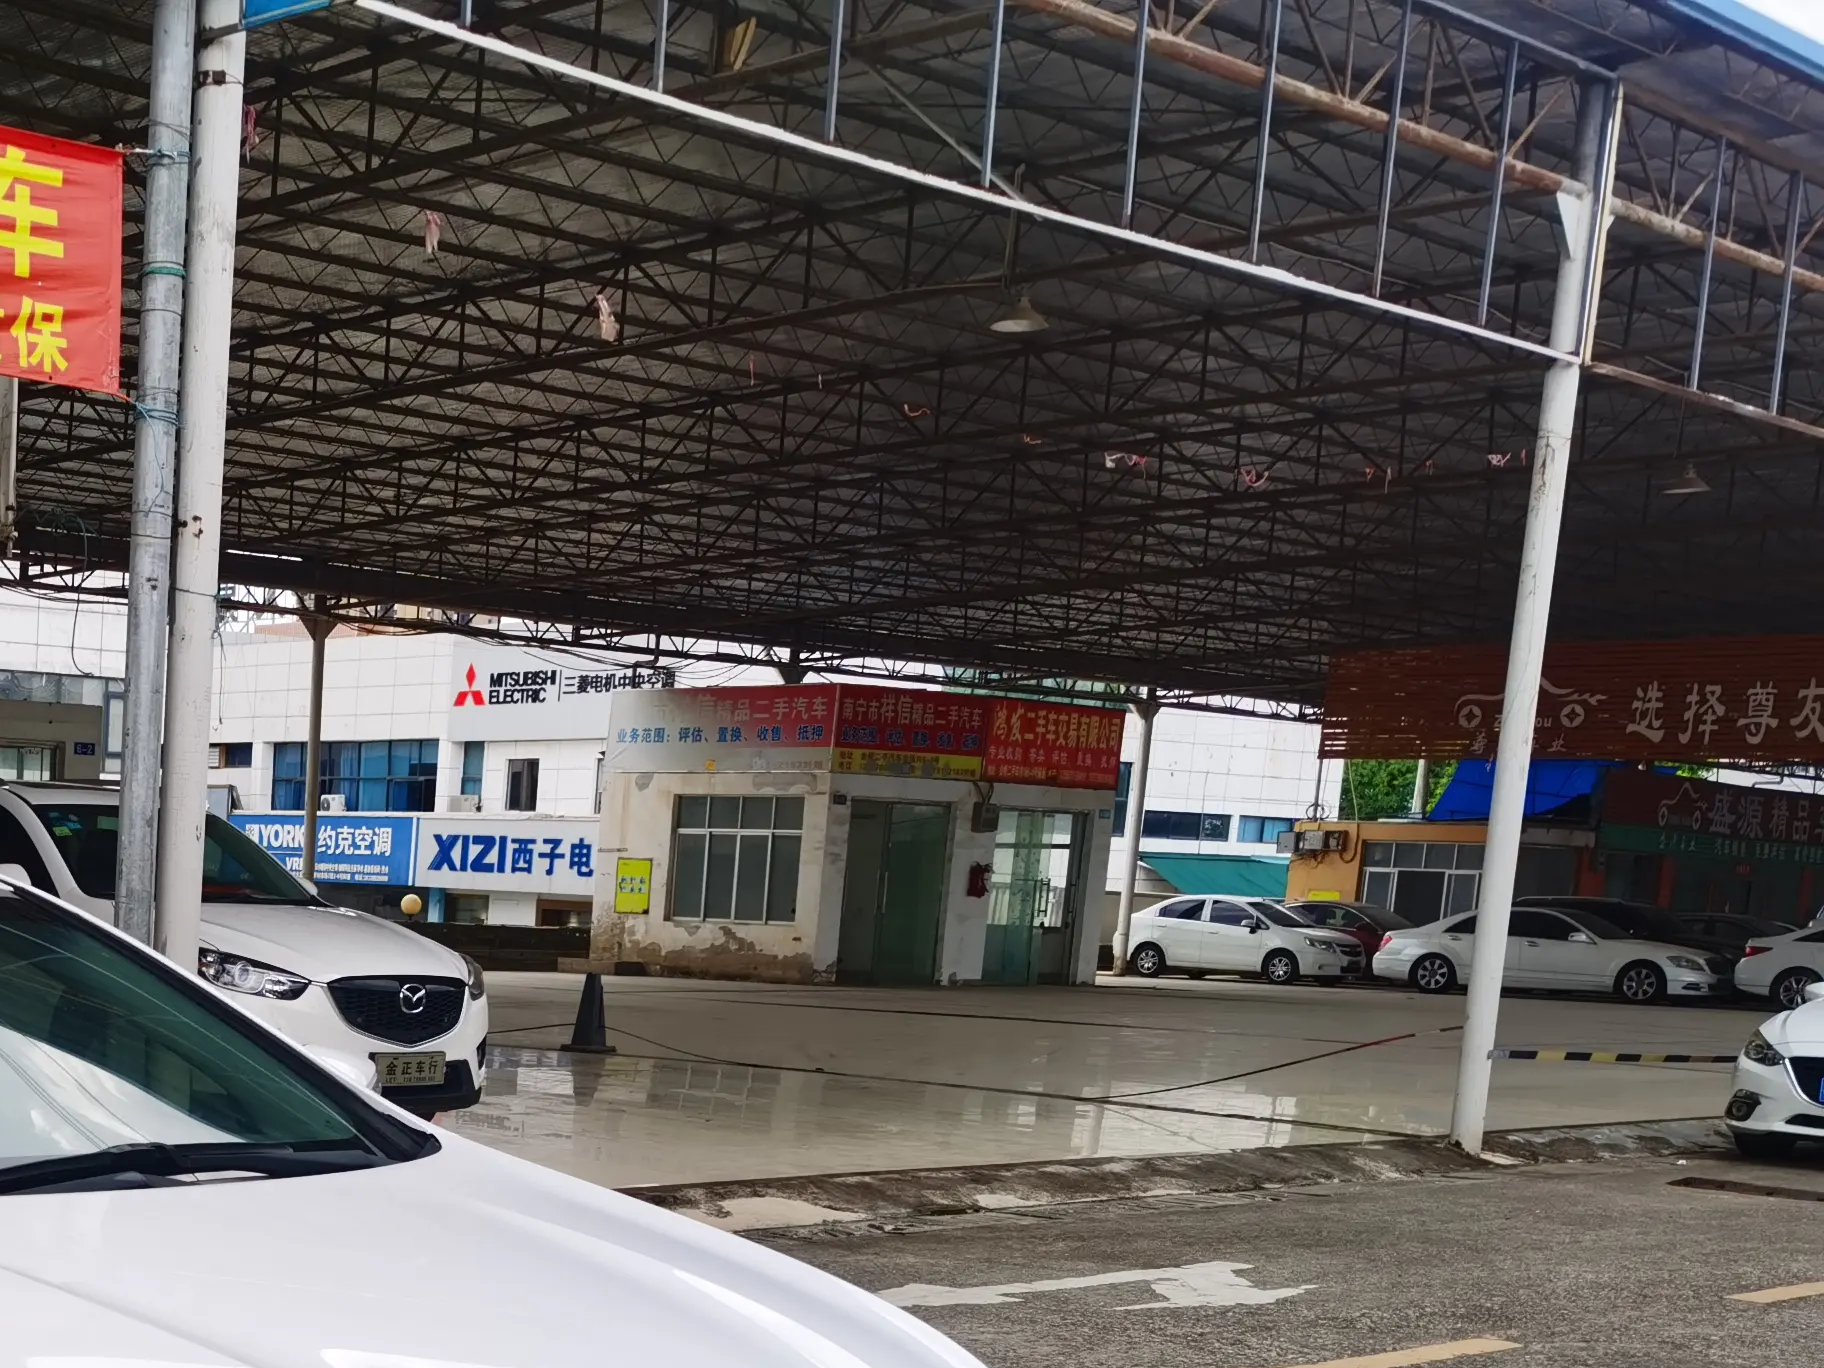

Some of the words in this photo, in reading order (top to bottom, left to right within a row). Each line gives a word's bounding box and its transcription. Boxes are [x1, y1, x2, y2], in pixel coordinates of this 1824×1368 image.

[489, 669, 557, 688] MITSUBISHI
[562, 670, 676, 695] 三菱电机中央空调
[488, 687, 547, 705] ELECTRIC
[842, 694, 983, 730] 南宁市祥信精品二手汽车
[1626, 677, 1824, 745] 选择尊友
[260, 823, 306, 849] YORK
[317, 825, 393, 857] 约克空调
[427, 833, 508, 874] XIZI
[510, 836, 594, 877] 西子电
[385, 1059, 439, 1076] 金正车行
